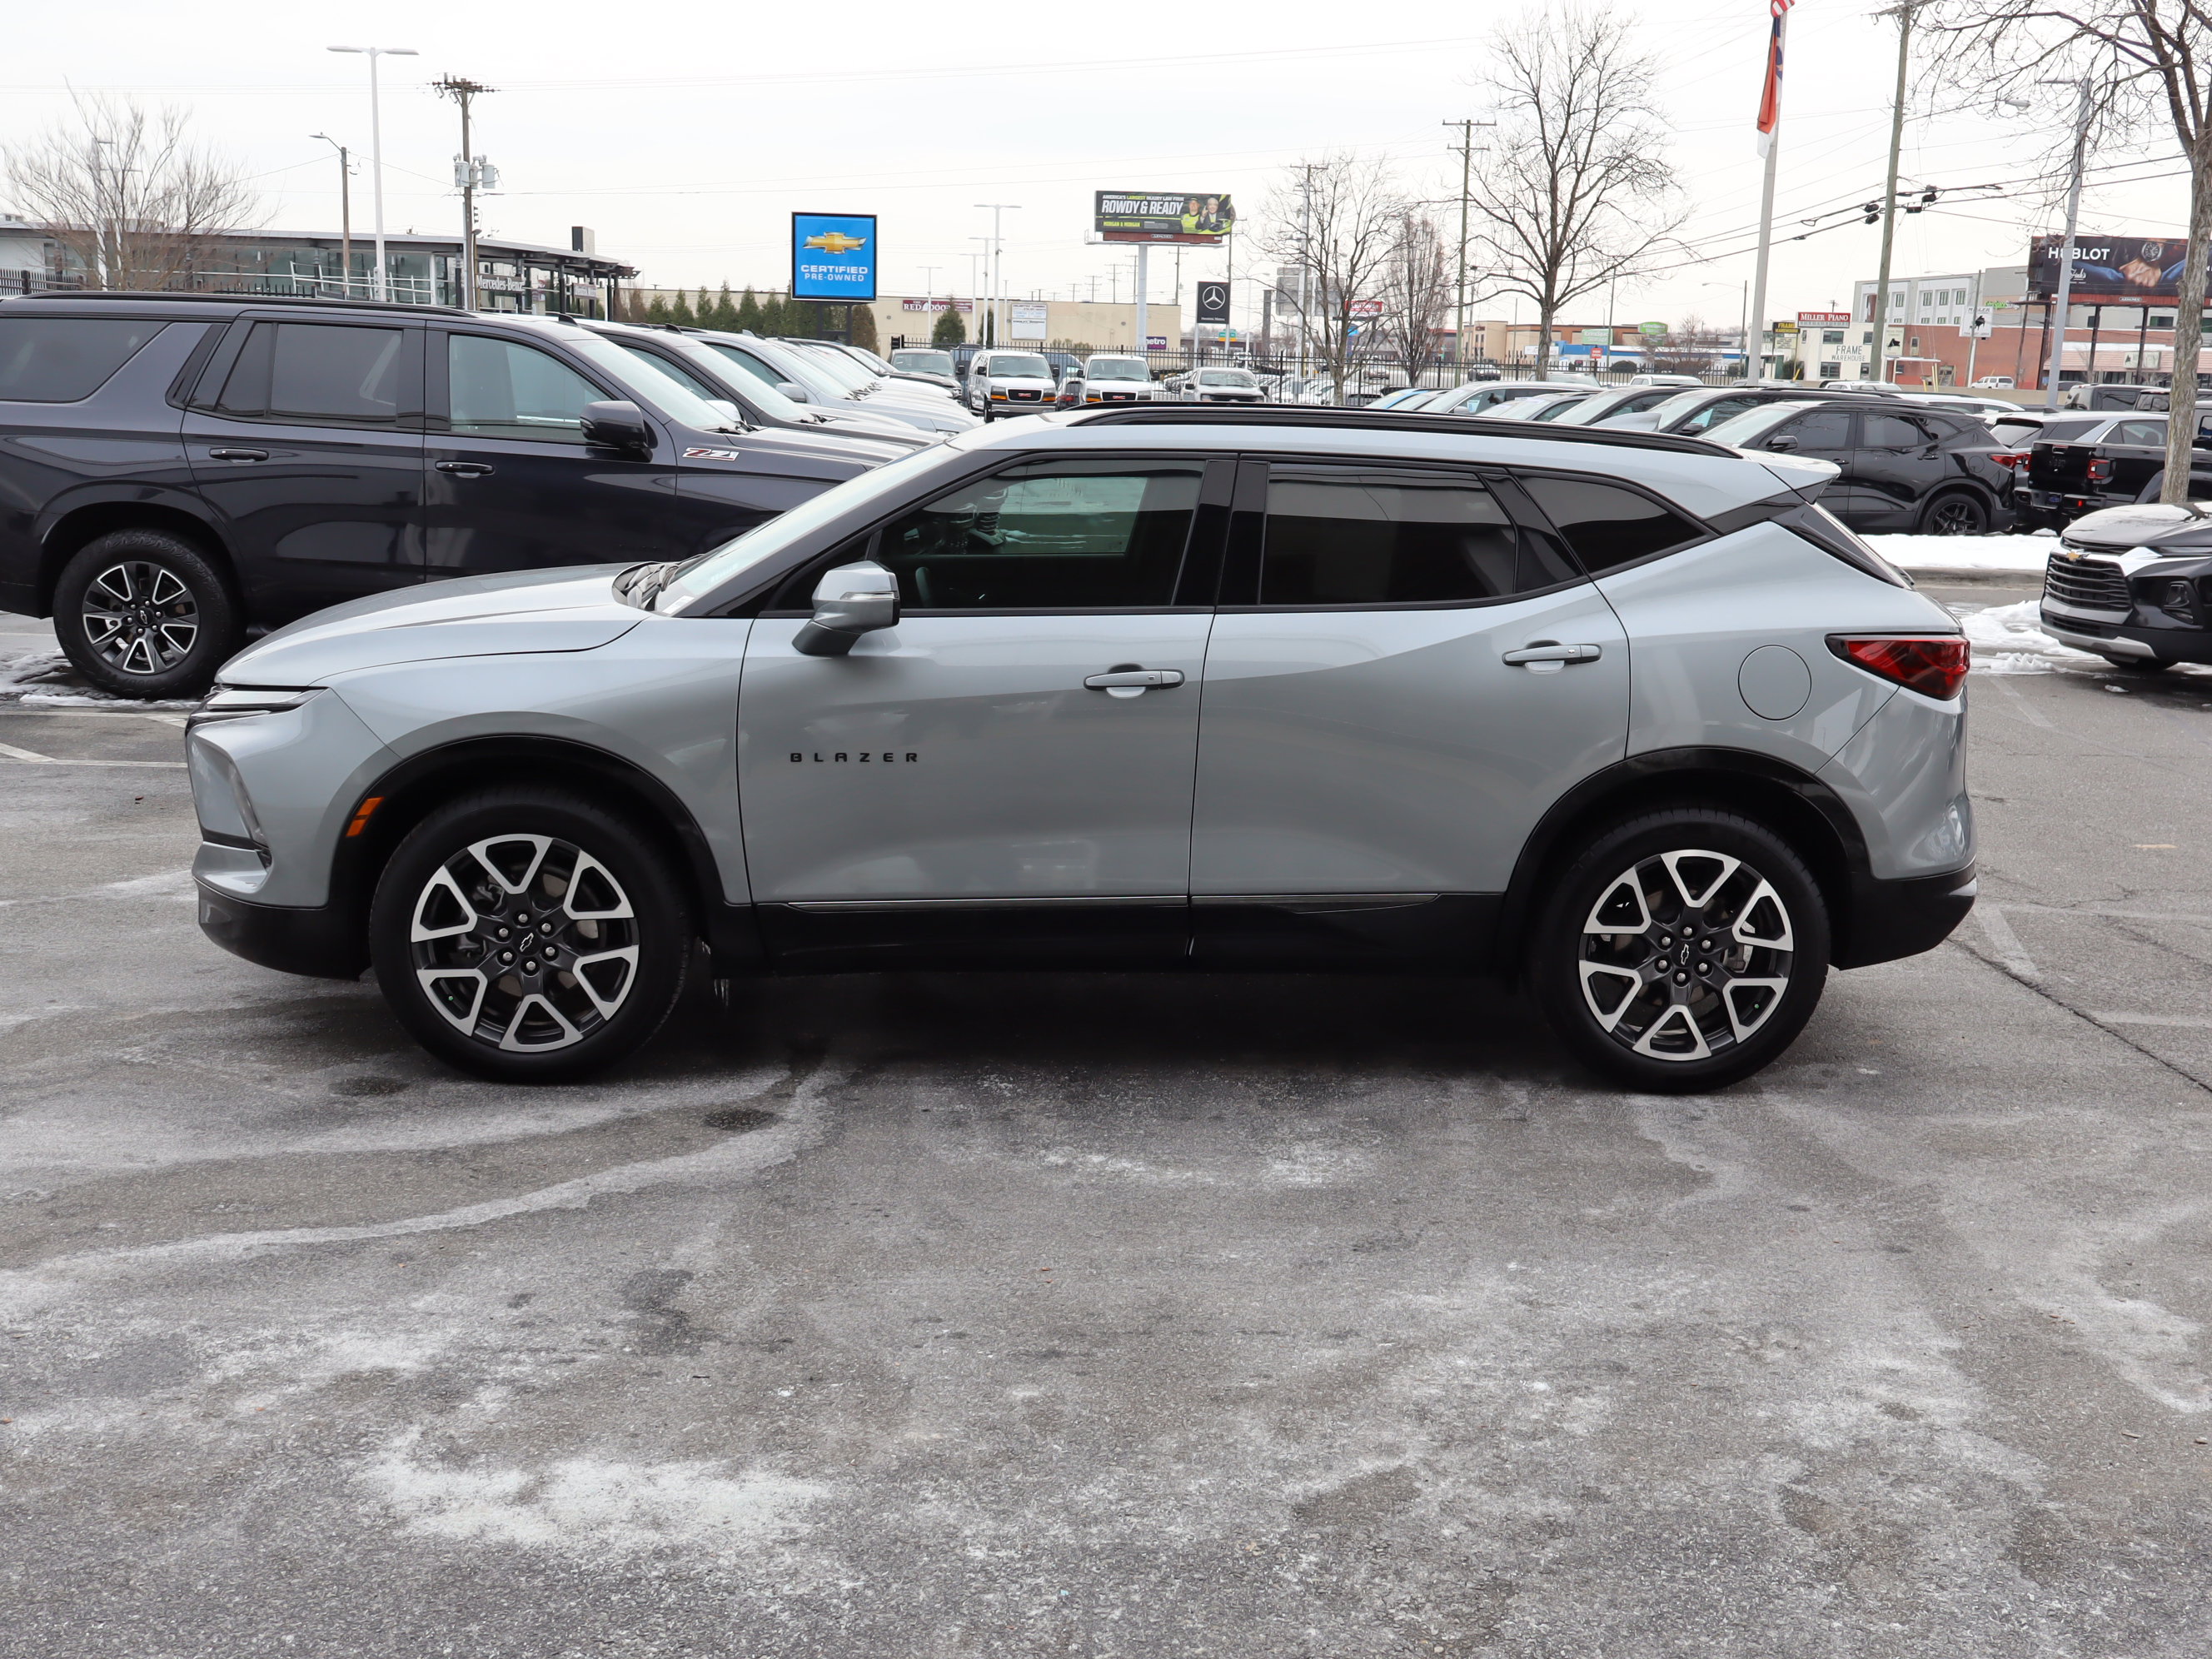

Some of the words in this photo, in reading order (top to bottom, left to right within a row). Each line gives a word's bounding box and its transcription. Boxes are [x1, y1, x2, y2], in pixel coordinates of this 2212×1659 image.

[1101, 200, 1141, 213] ROWDY
[1140, 201, 1148, 214] &
[1149, 202, 1184, 215] READY
[2048, 247, 2110, 261] HBLOT
[800, 264, 868, 274] CERTIFIED
[478, 275, 526, 291] Mercedes-Benz
[805, 273, 864, 281] PRE-OWNED
[1836, 346, 1862, 355] FRAME
[682, 447, 740, 461] Z71
[790, 752, 918, 763] BLAZER
